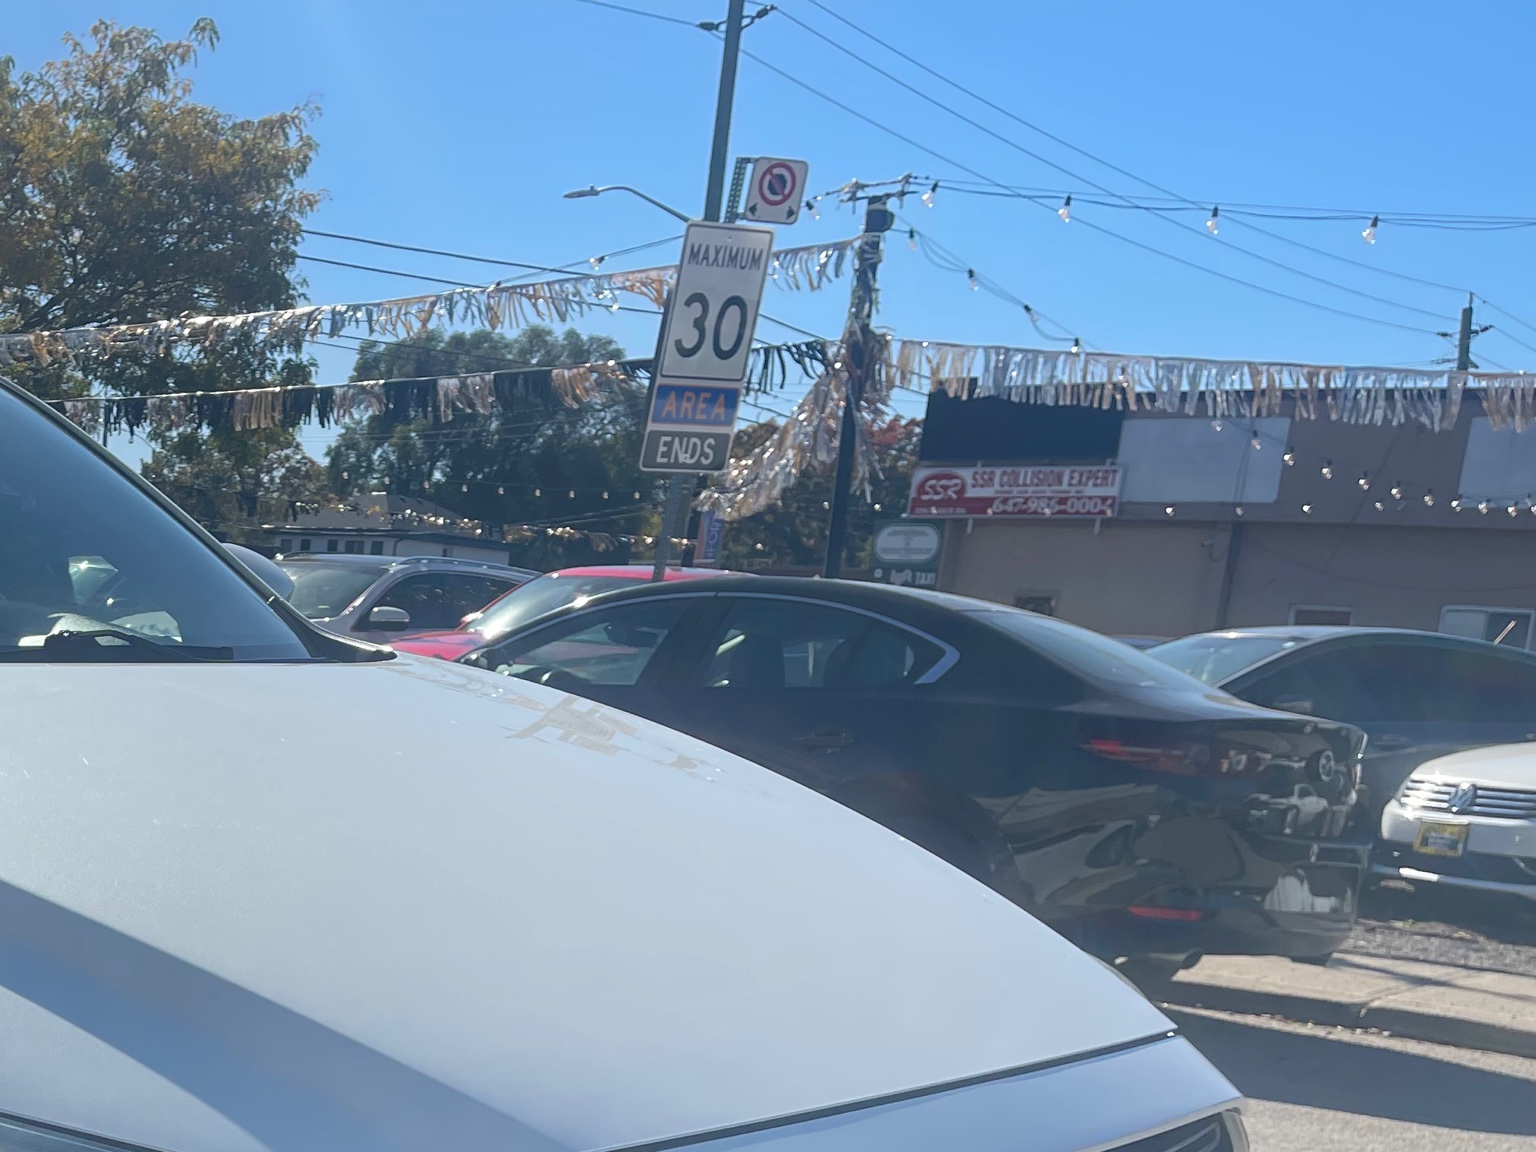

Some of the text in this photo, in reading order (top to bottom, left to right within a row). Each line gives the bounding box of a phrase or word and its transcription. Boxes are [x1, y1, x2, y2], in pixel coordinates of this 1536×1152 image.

[687, 243, 764, 272] MAXIMUM
[674, 292, 748, 361] 30
[661, 391, 726, 422] AREA
[656, 436, 716, 465] ENDS
[921, 478, 963, 501] SSR
[971, 469, 1119, 488] SSR COLLISION EXPERT
